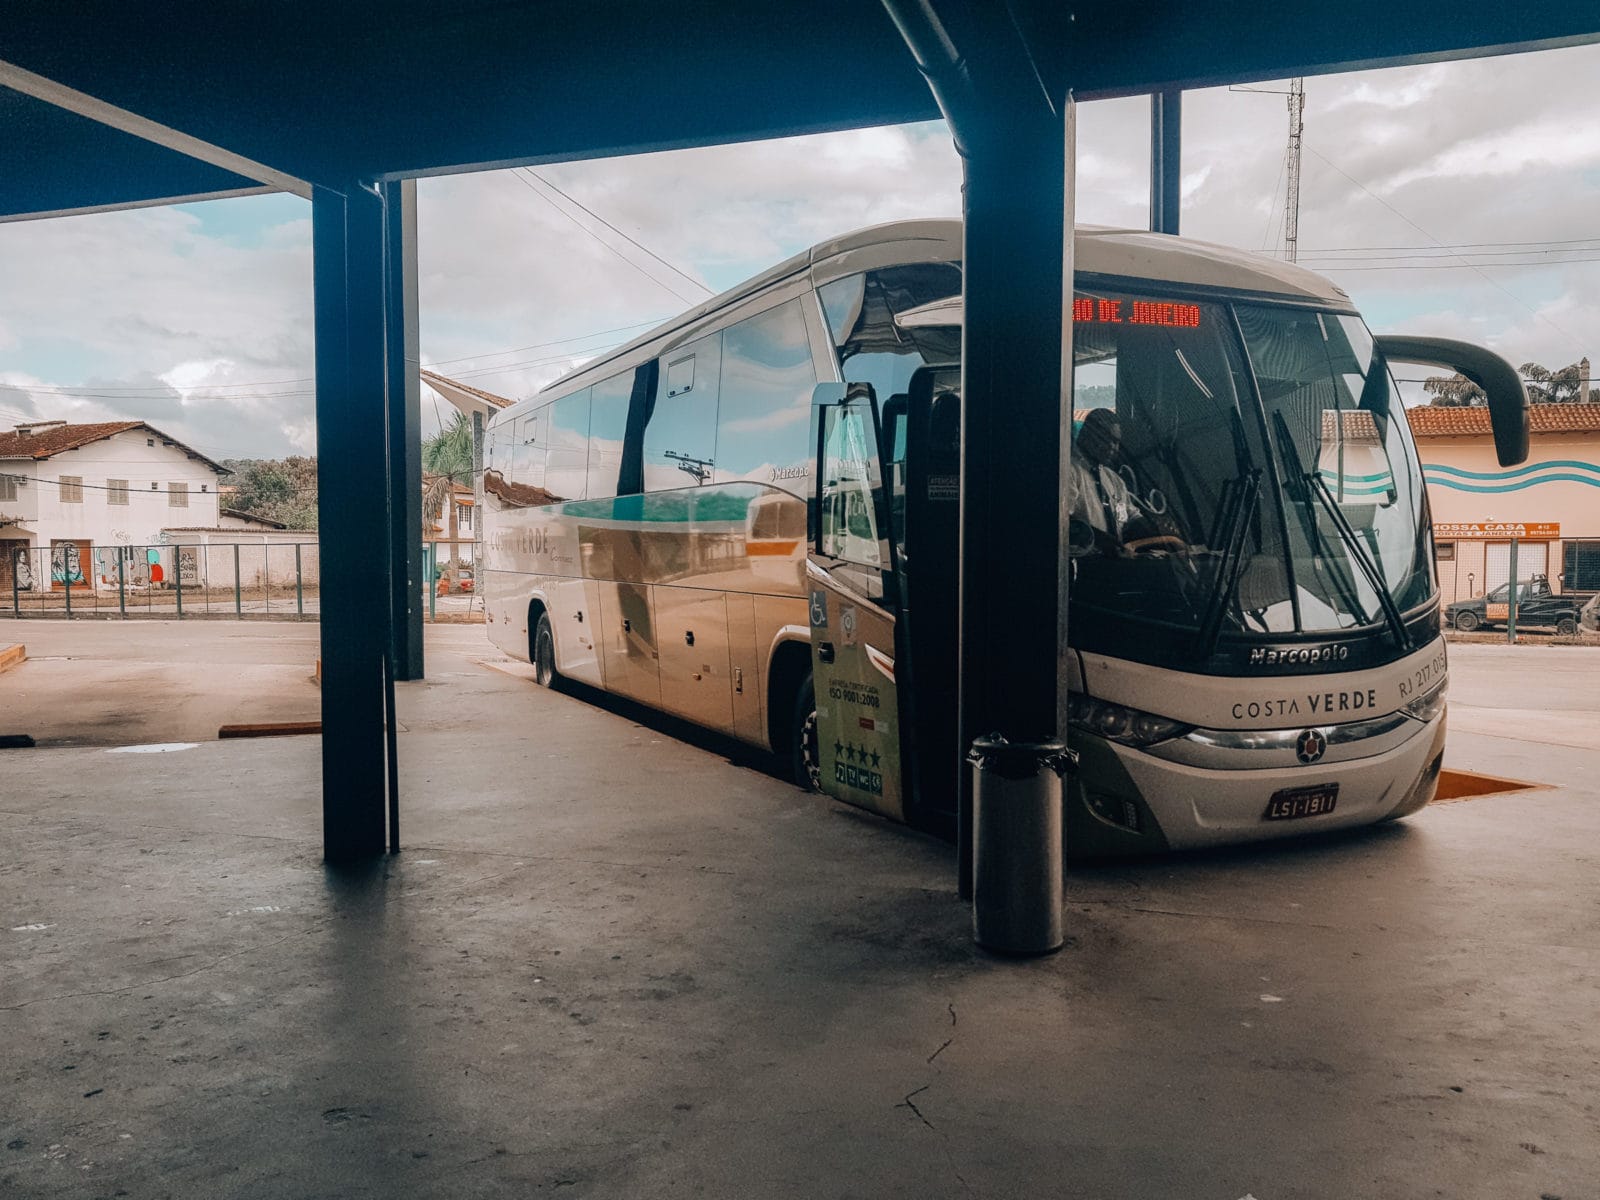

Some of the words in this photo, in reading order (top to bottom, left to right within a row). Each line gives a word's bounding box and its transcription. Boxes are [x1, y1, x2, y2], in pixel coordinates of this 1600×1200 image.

[1099, 298, 1122, 322] DE
[1128, 301, 1200, 328] JANEIRO
[1484, 523, 1526, 531] CASA
[1250, 644, 1349, 664] Marcopolo
[829, 687, 842, 700] ISO
[842, 689, 880, 709] 9001:2008
[1398, 677, 1413, 698] RJ
[1231, 698, 1300, 719] COSTA
[1307, 689, 1376, 714] VERDE
